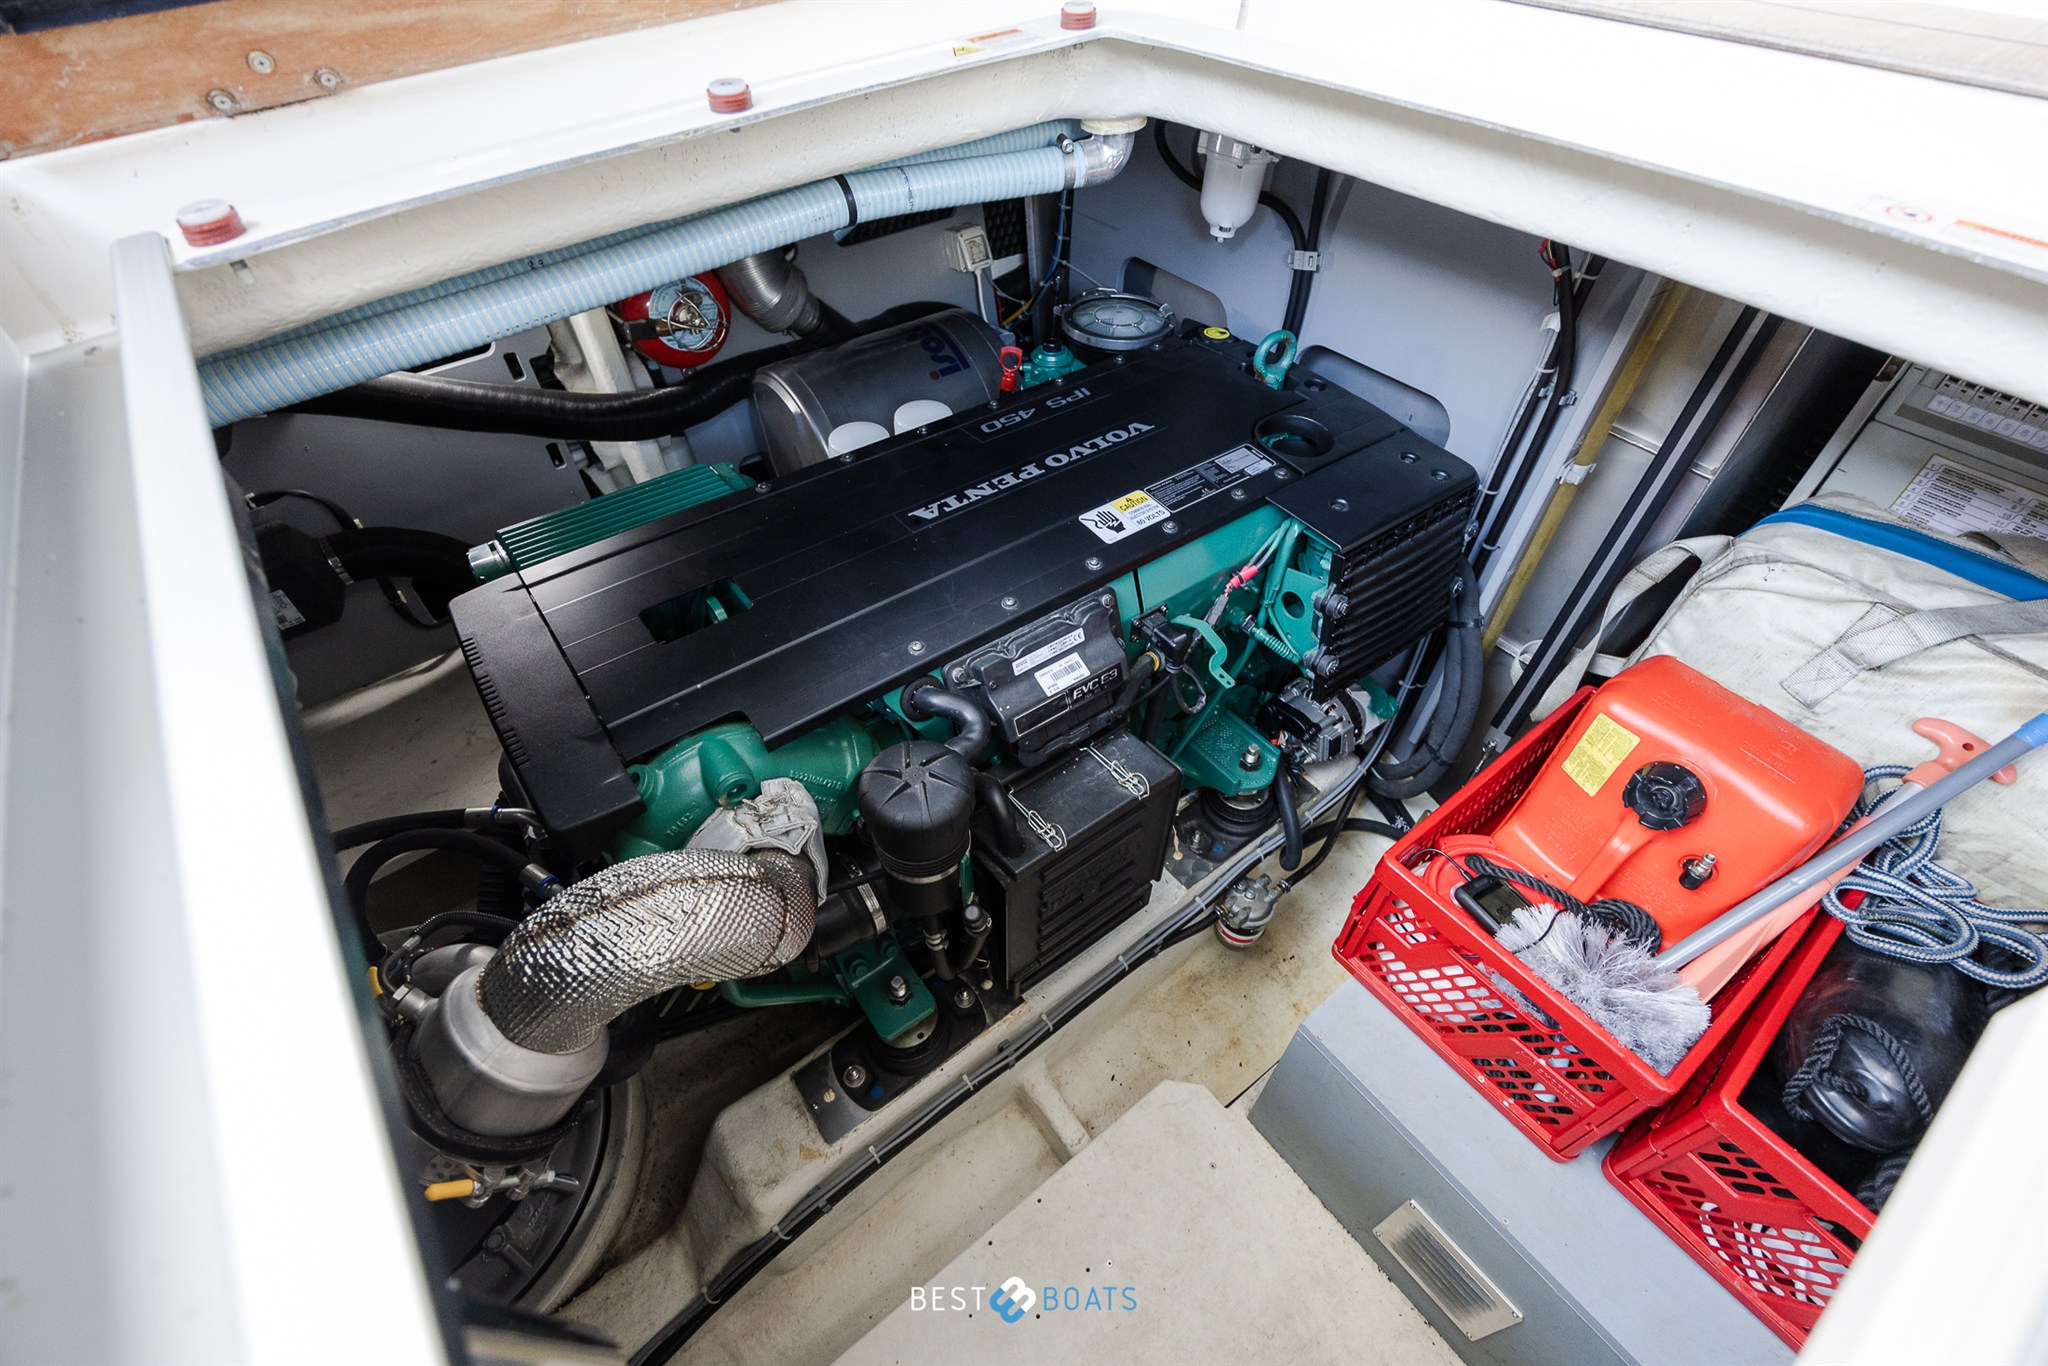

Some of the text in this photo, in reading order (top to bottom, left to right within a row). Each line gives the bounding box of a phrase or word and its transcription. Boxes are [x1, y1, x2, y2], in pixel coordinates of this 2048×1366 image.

[980, 387, 1092, 433] IPS 450
[1044, 422, 1156, 467] VOLVO
[907, 463, 1046, 520] PENTA
[1119, 496, 1149, 511] CAUTION
[1144, 510, 1166, 521] VOLTS
[1073, 678, 1100, 700] EVC
[1101, 668, 1118, 684] E3
